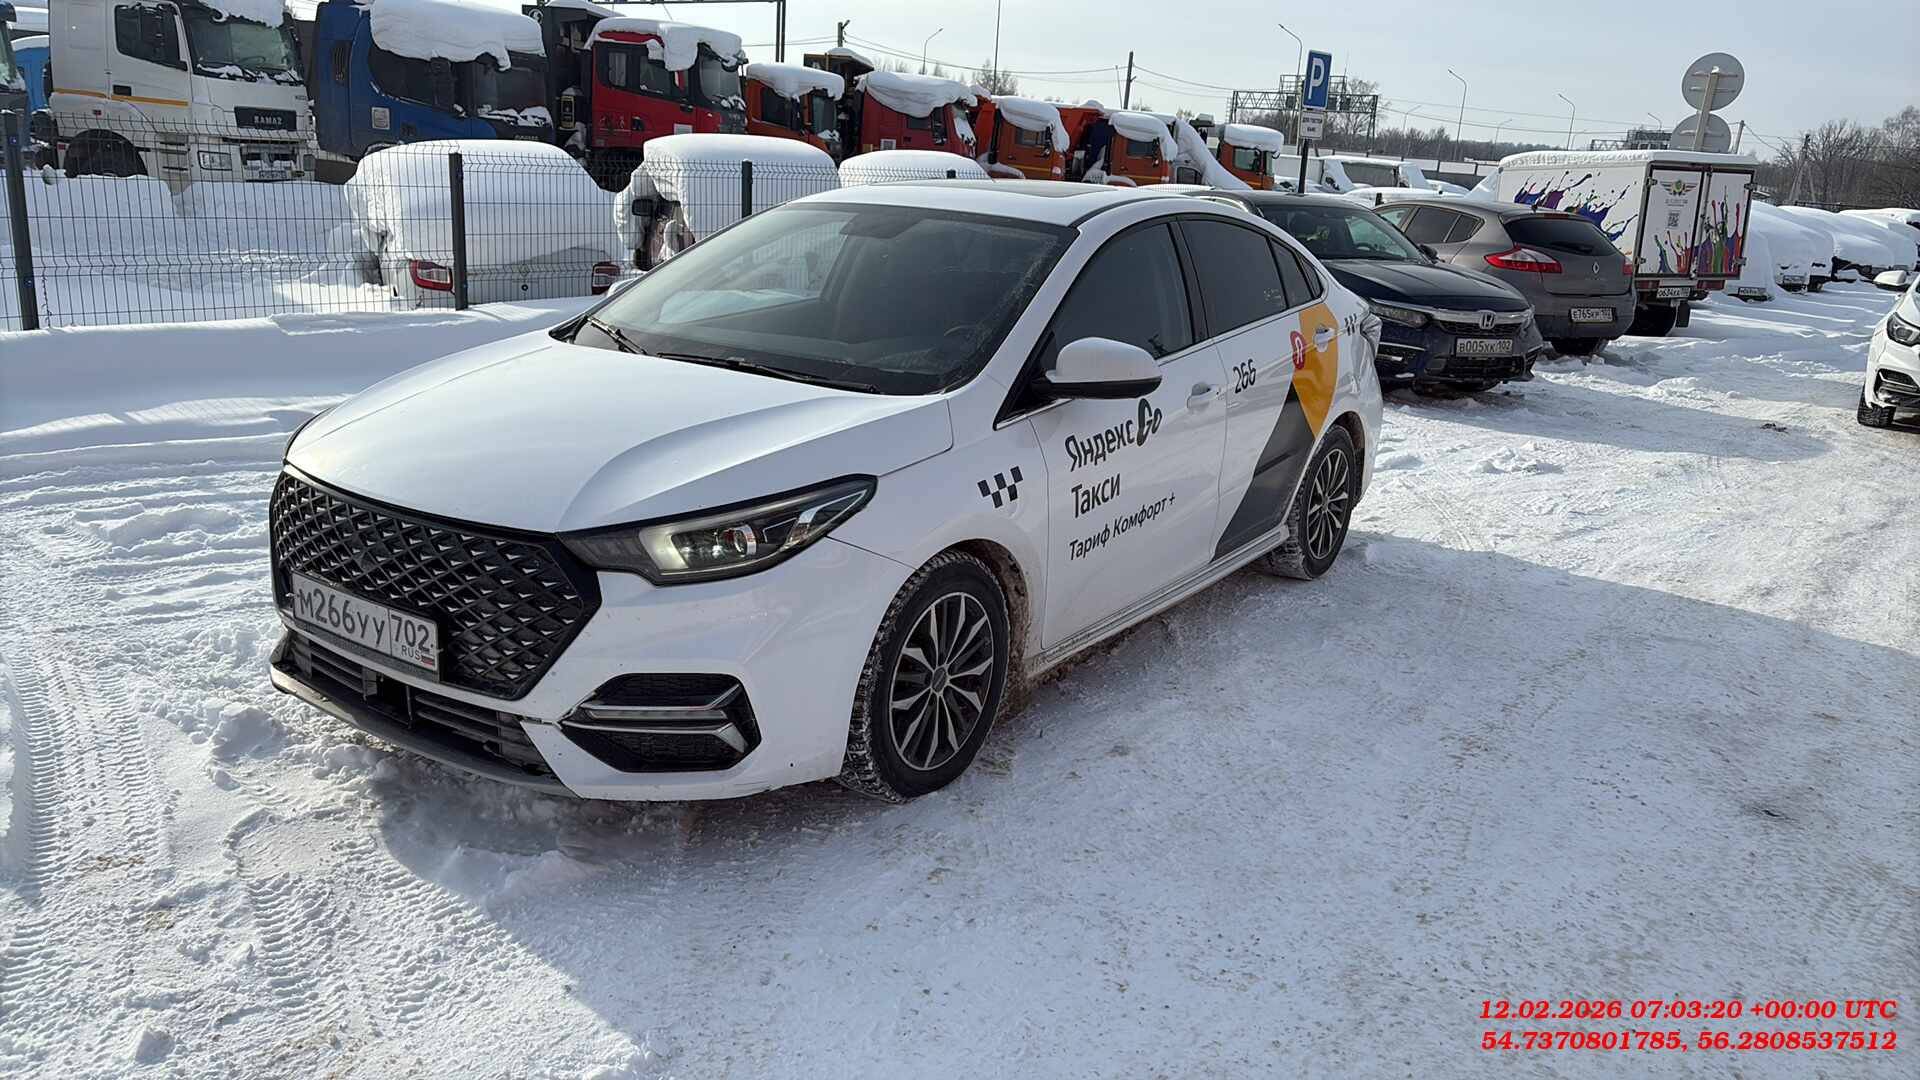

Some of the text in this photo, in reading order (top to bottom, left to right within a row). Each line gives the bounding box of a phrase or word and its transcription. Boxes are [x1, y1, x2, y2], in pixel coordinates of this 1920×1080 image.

[1308, 57, 1325, 100] P
[1233, 358, 1257, 394] 266
[1065, 419, 1135, 472] Яндекс
[1071, 473, 1121, 518] Такси
[1069, 523, 1111, 561] Тариф
[298, 588, 430, 654] М266УУ 702
[401, 644, 422, 661] RUS
